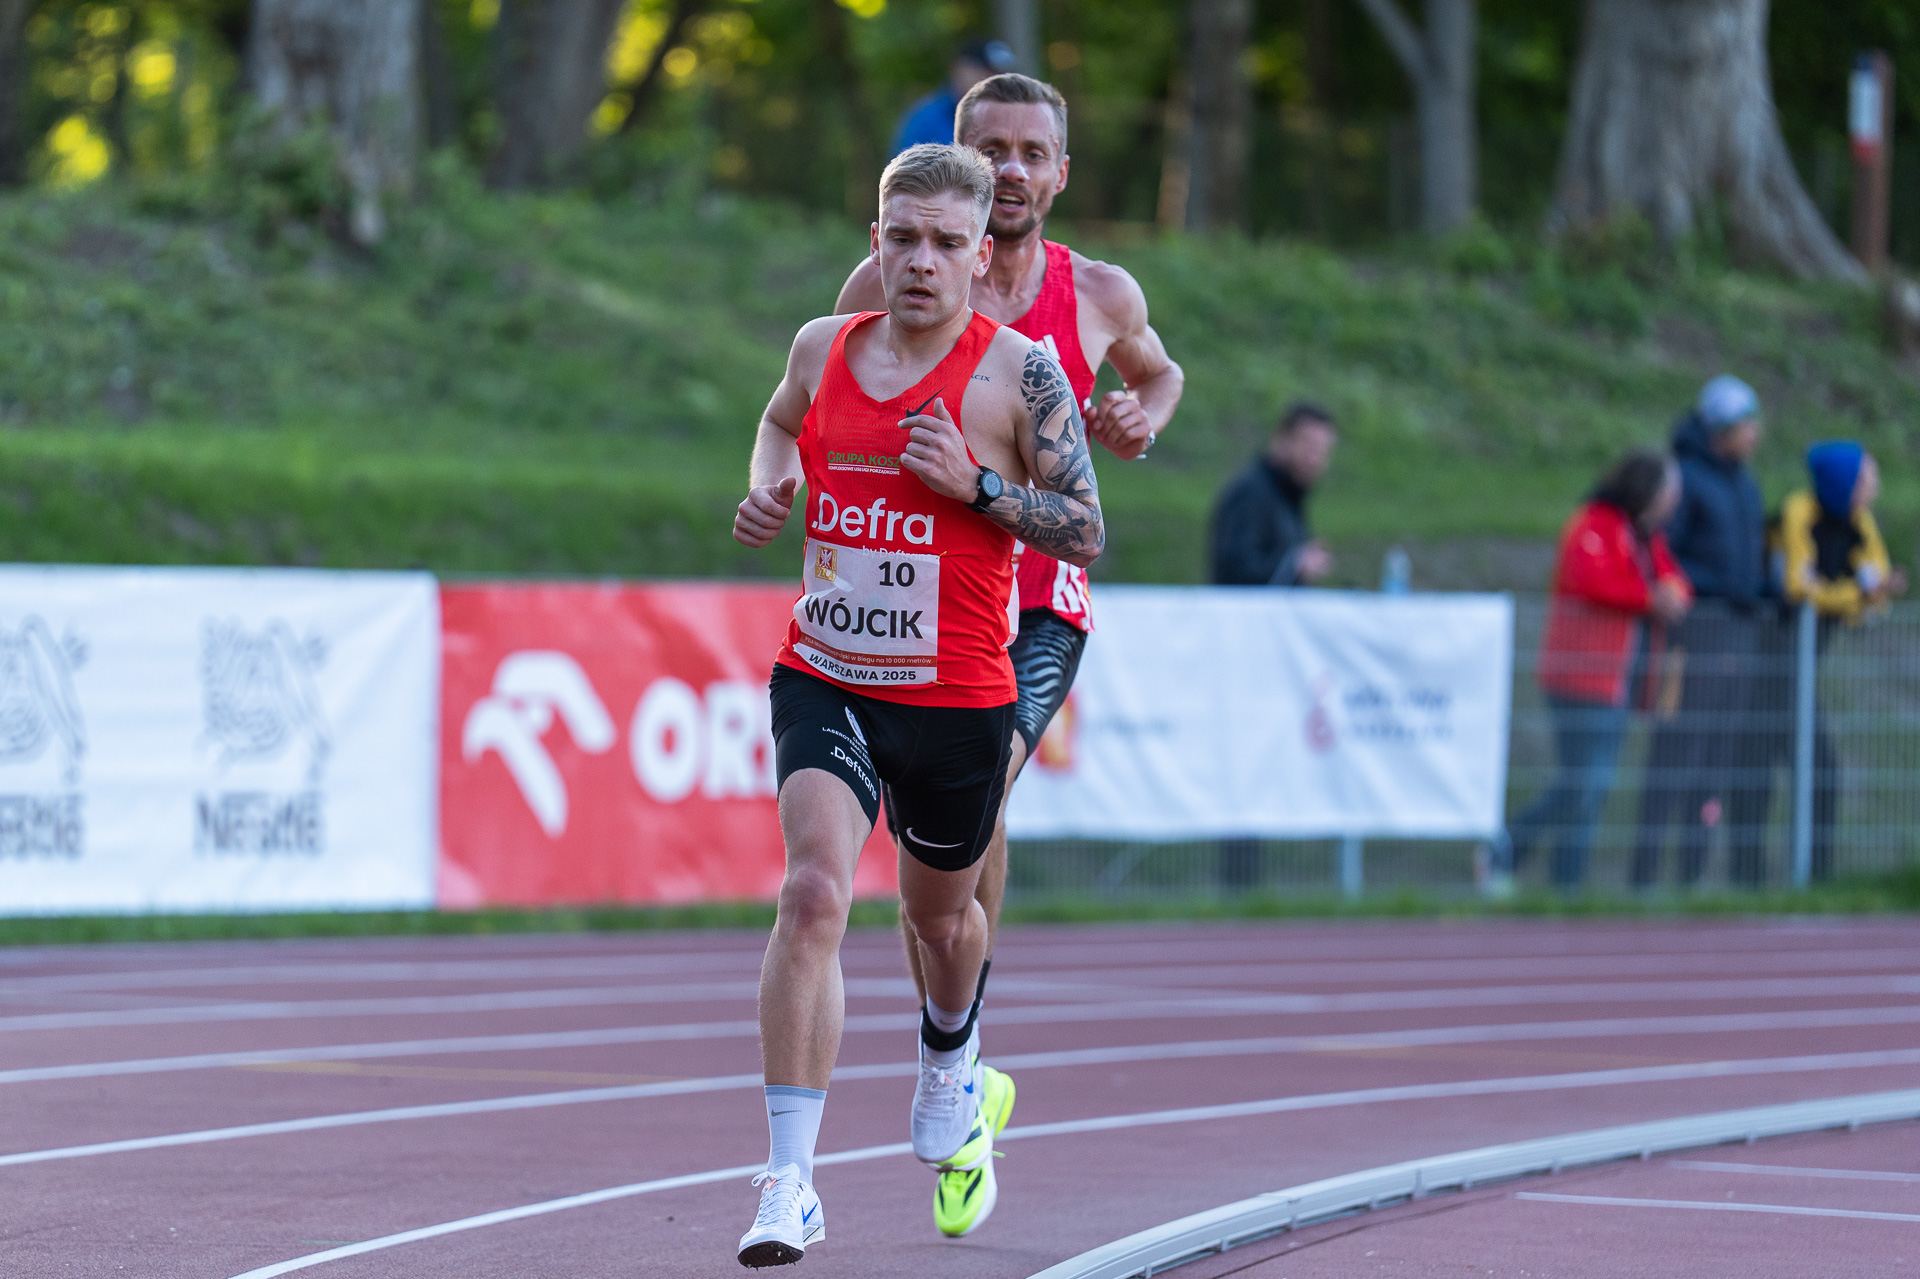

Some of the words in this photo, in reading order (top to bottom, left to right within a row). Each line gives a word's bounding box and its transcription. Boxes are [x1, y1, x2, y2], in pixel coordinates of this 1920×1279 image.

[827, 450, 866, 464] GRUPA
[868, 455, 901, 468] KOSZ
[811, 491, 935, 546] .Defra
[862, 545, 877, 558] by
[878, 561, 916, 588] 10
[804, 595, 924, 640] WÓJCIK
[809, 653, 879, 681] WARSZAWA
[882, 670, 917, 681] 2025
[857, 655, 875, 664] Biegu
[907, 656, 932, 664] metrów
[630, 677, 777, 802] OR
